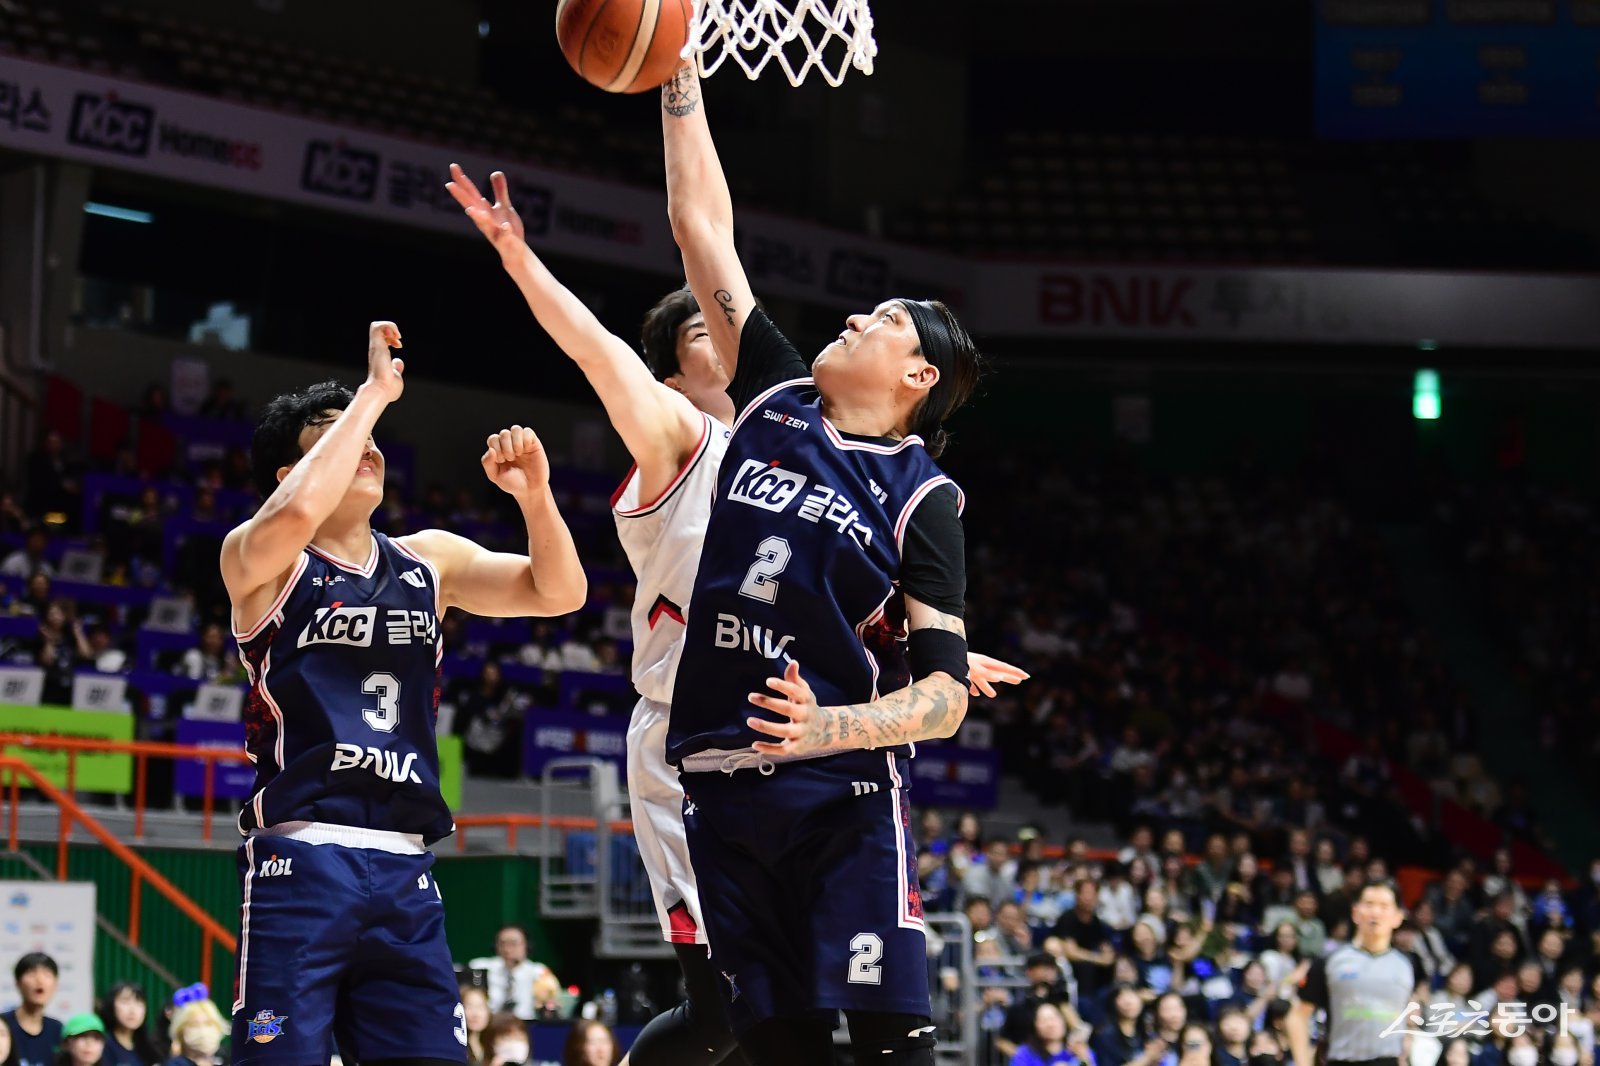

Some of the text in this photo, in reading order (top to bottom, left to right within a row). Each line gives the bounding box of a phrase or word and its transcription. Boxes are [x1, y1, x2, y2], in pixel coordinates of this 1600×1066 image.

[74, 95, 150, 152] KCC
[1038, 274, 1197, 328] BNK
[731, 459, 800, 508] KCC
[738, 535, 792, 605] 2
[303, 602, 370, 644] KCC
[361, 671, 402, 733] 3
[330, 743, 422, 784] BNK
[259, 855, 293, 877] KBL
[847, 932, 883, 986] 2
